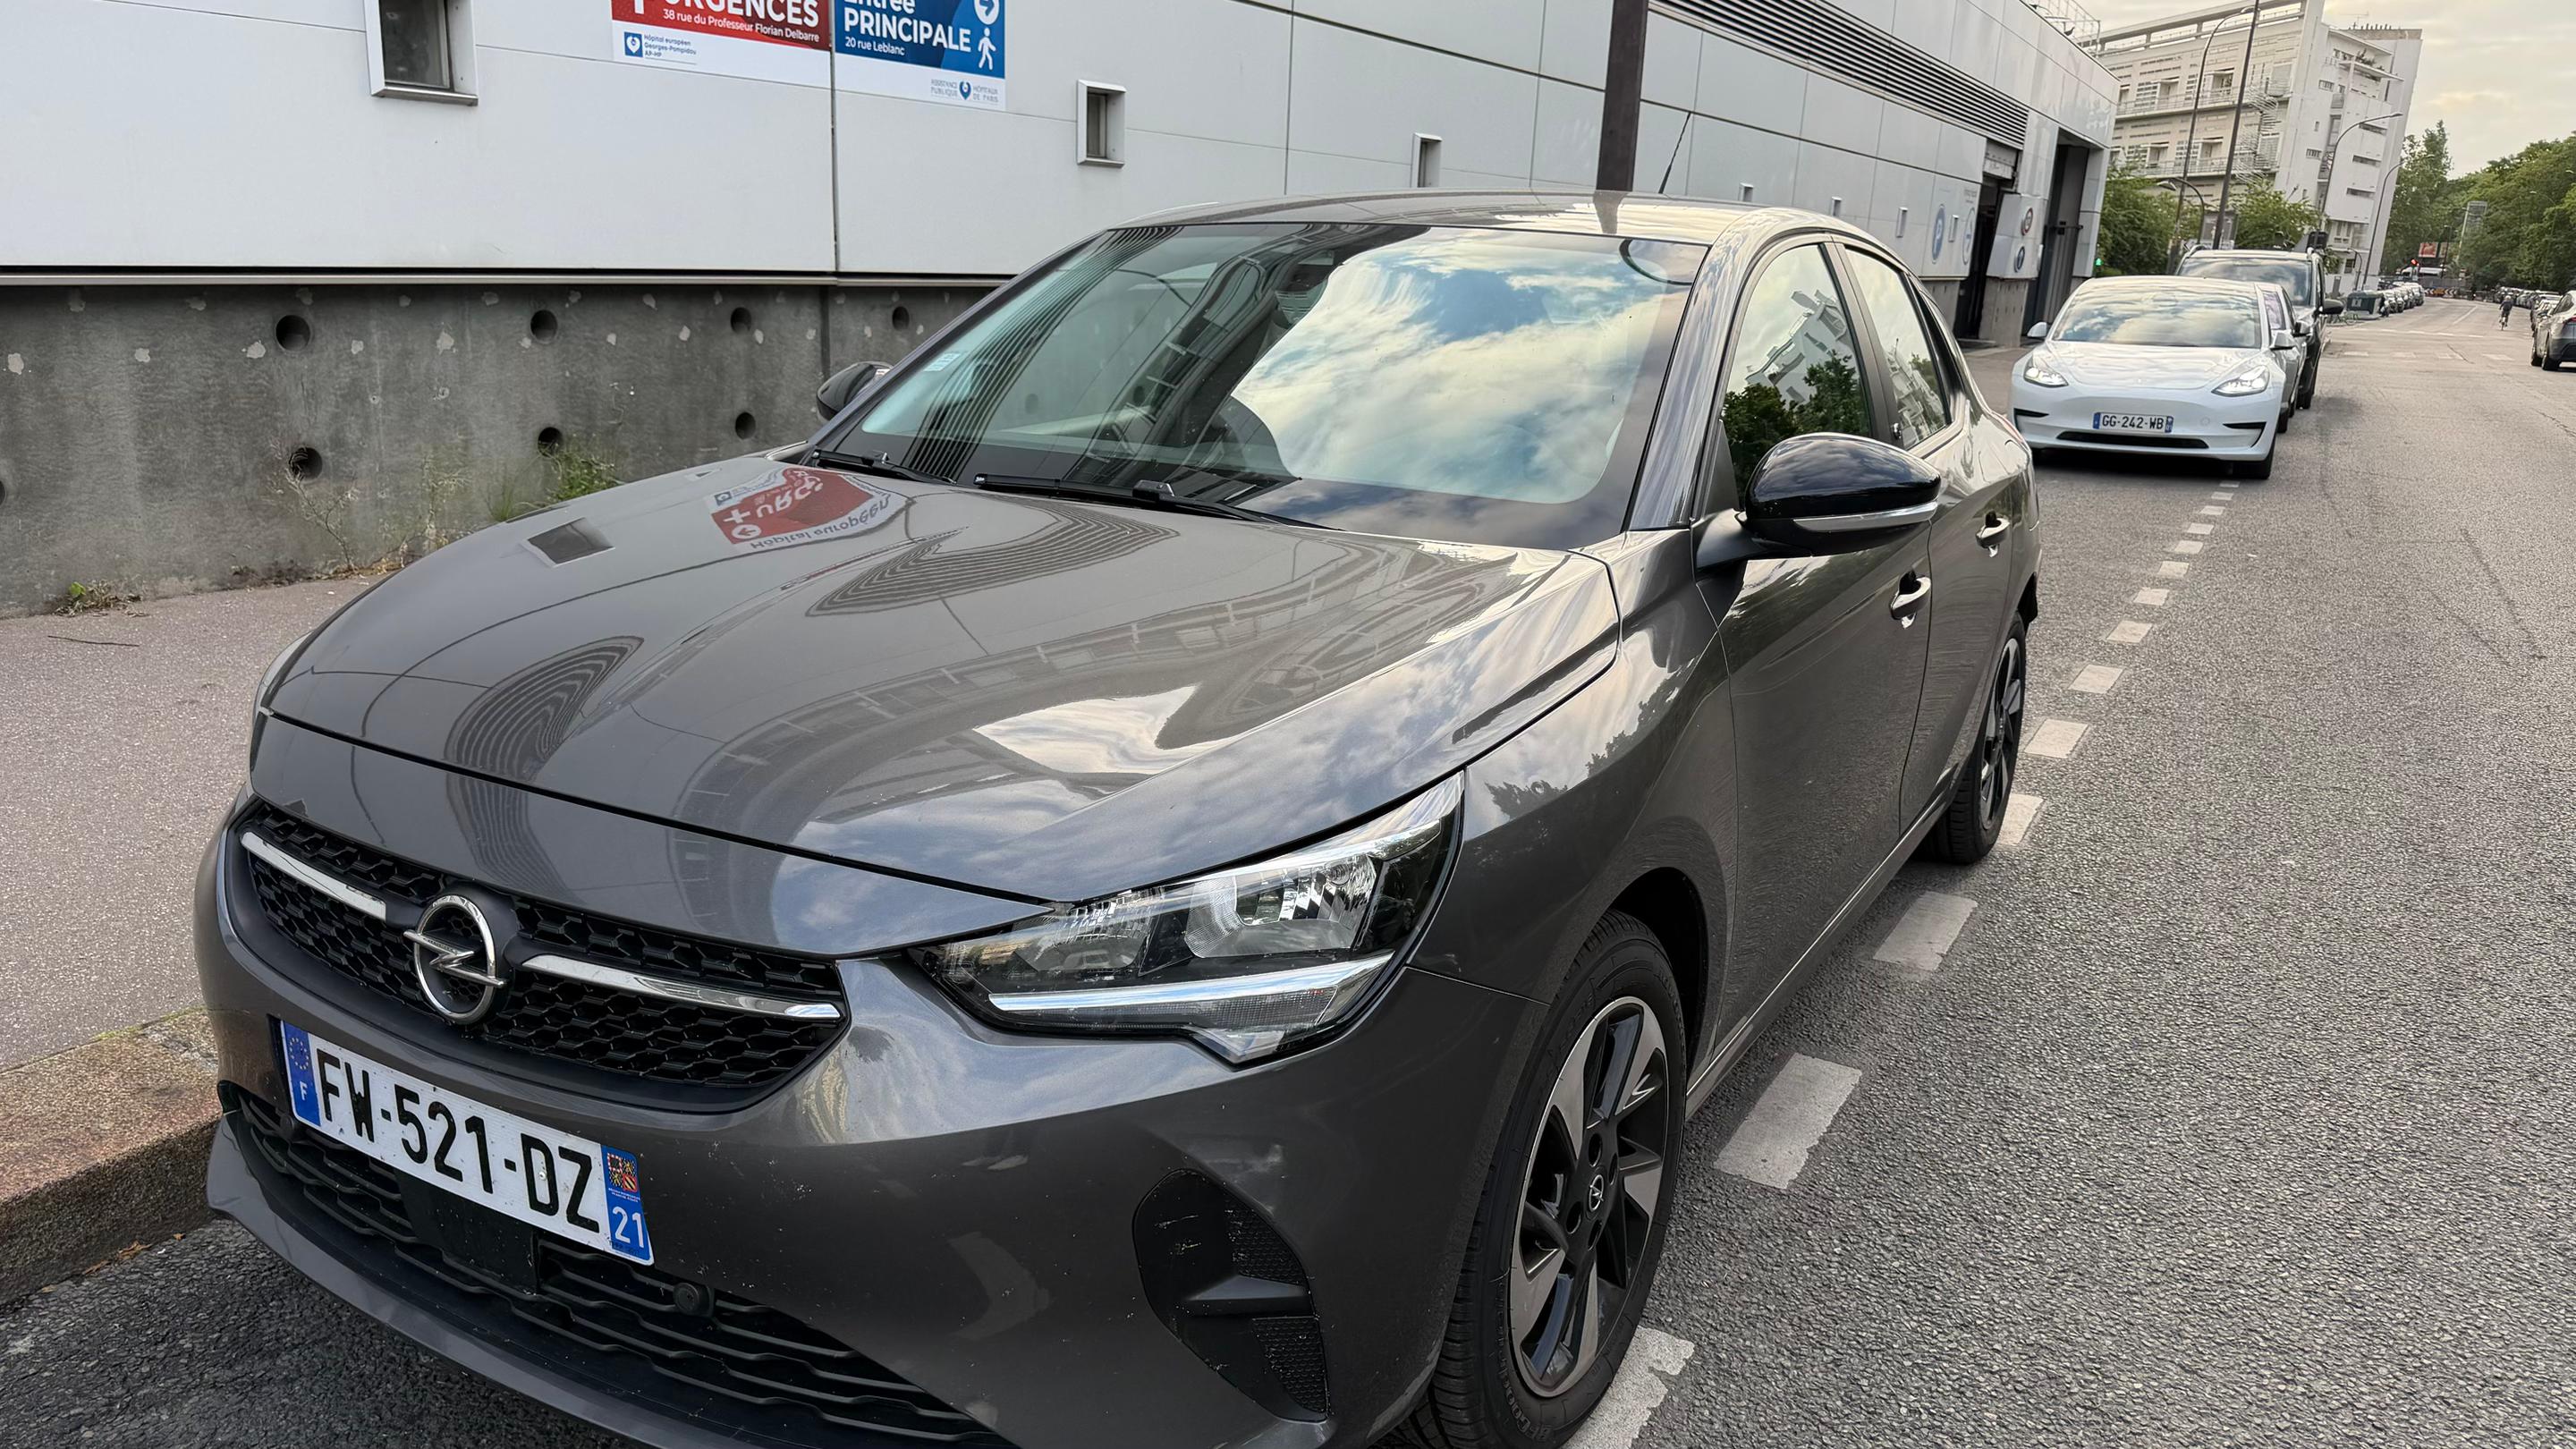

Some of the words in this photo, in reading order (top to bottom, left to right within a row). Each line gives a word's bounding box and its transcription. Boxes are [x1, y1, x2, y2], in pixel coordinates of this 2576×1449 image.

[663, 8, 675, 20] 38
[677, 13, 692, 23] rue
[693, 13, 707, 25] du
[708, 15, 754, 32] Professeur
[755, 22, 784, 37] Florian
[784, 28, 820, 43] Delbarre
[664, 0, 819, 28] ENCES
[843, 6, 972, 52] PRINCIPALE
[844, 36, 857, 48] 20
[857, 40, 873, 52] rue
[873, 41, 906, 56] Leblanc
[2101, 414, 2165, 430] GG-242-WB
[299, 1080, 309, 1101] F
[316, 1047, 601, 1234] FW-521-DZ
[612, 1206, 645, 1249] 21
